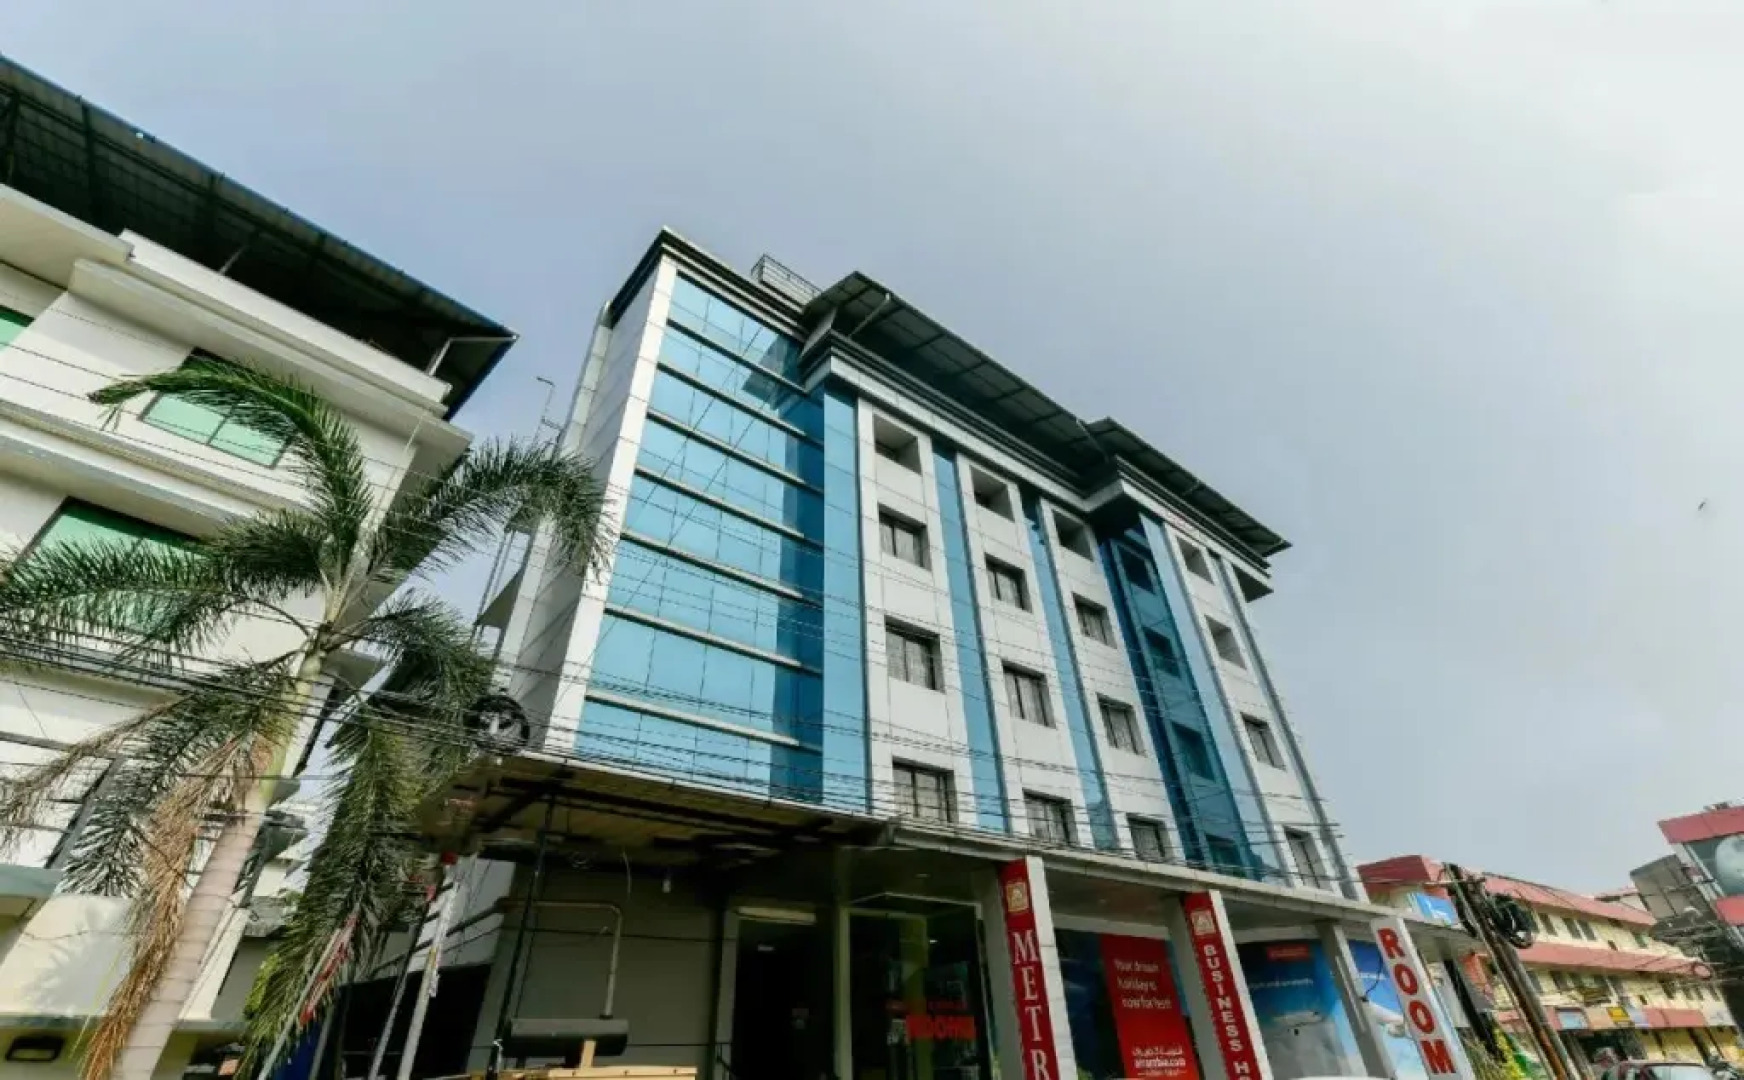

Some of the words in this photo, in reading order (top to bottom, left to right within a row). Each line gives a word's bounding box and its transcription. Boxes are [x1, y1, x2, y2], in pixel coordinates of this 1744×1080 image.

[1012, 929, 1051, 1080] METR
[1203, 944, 1243, 1052] BUSINESS
[1377, 927, 1457, 1075] ROOM
